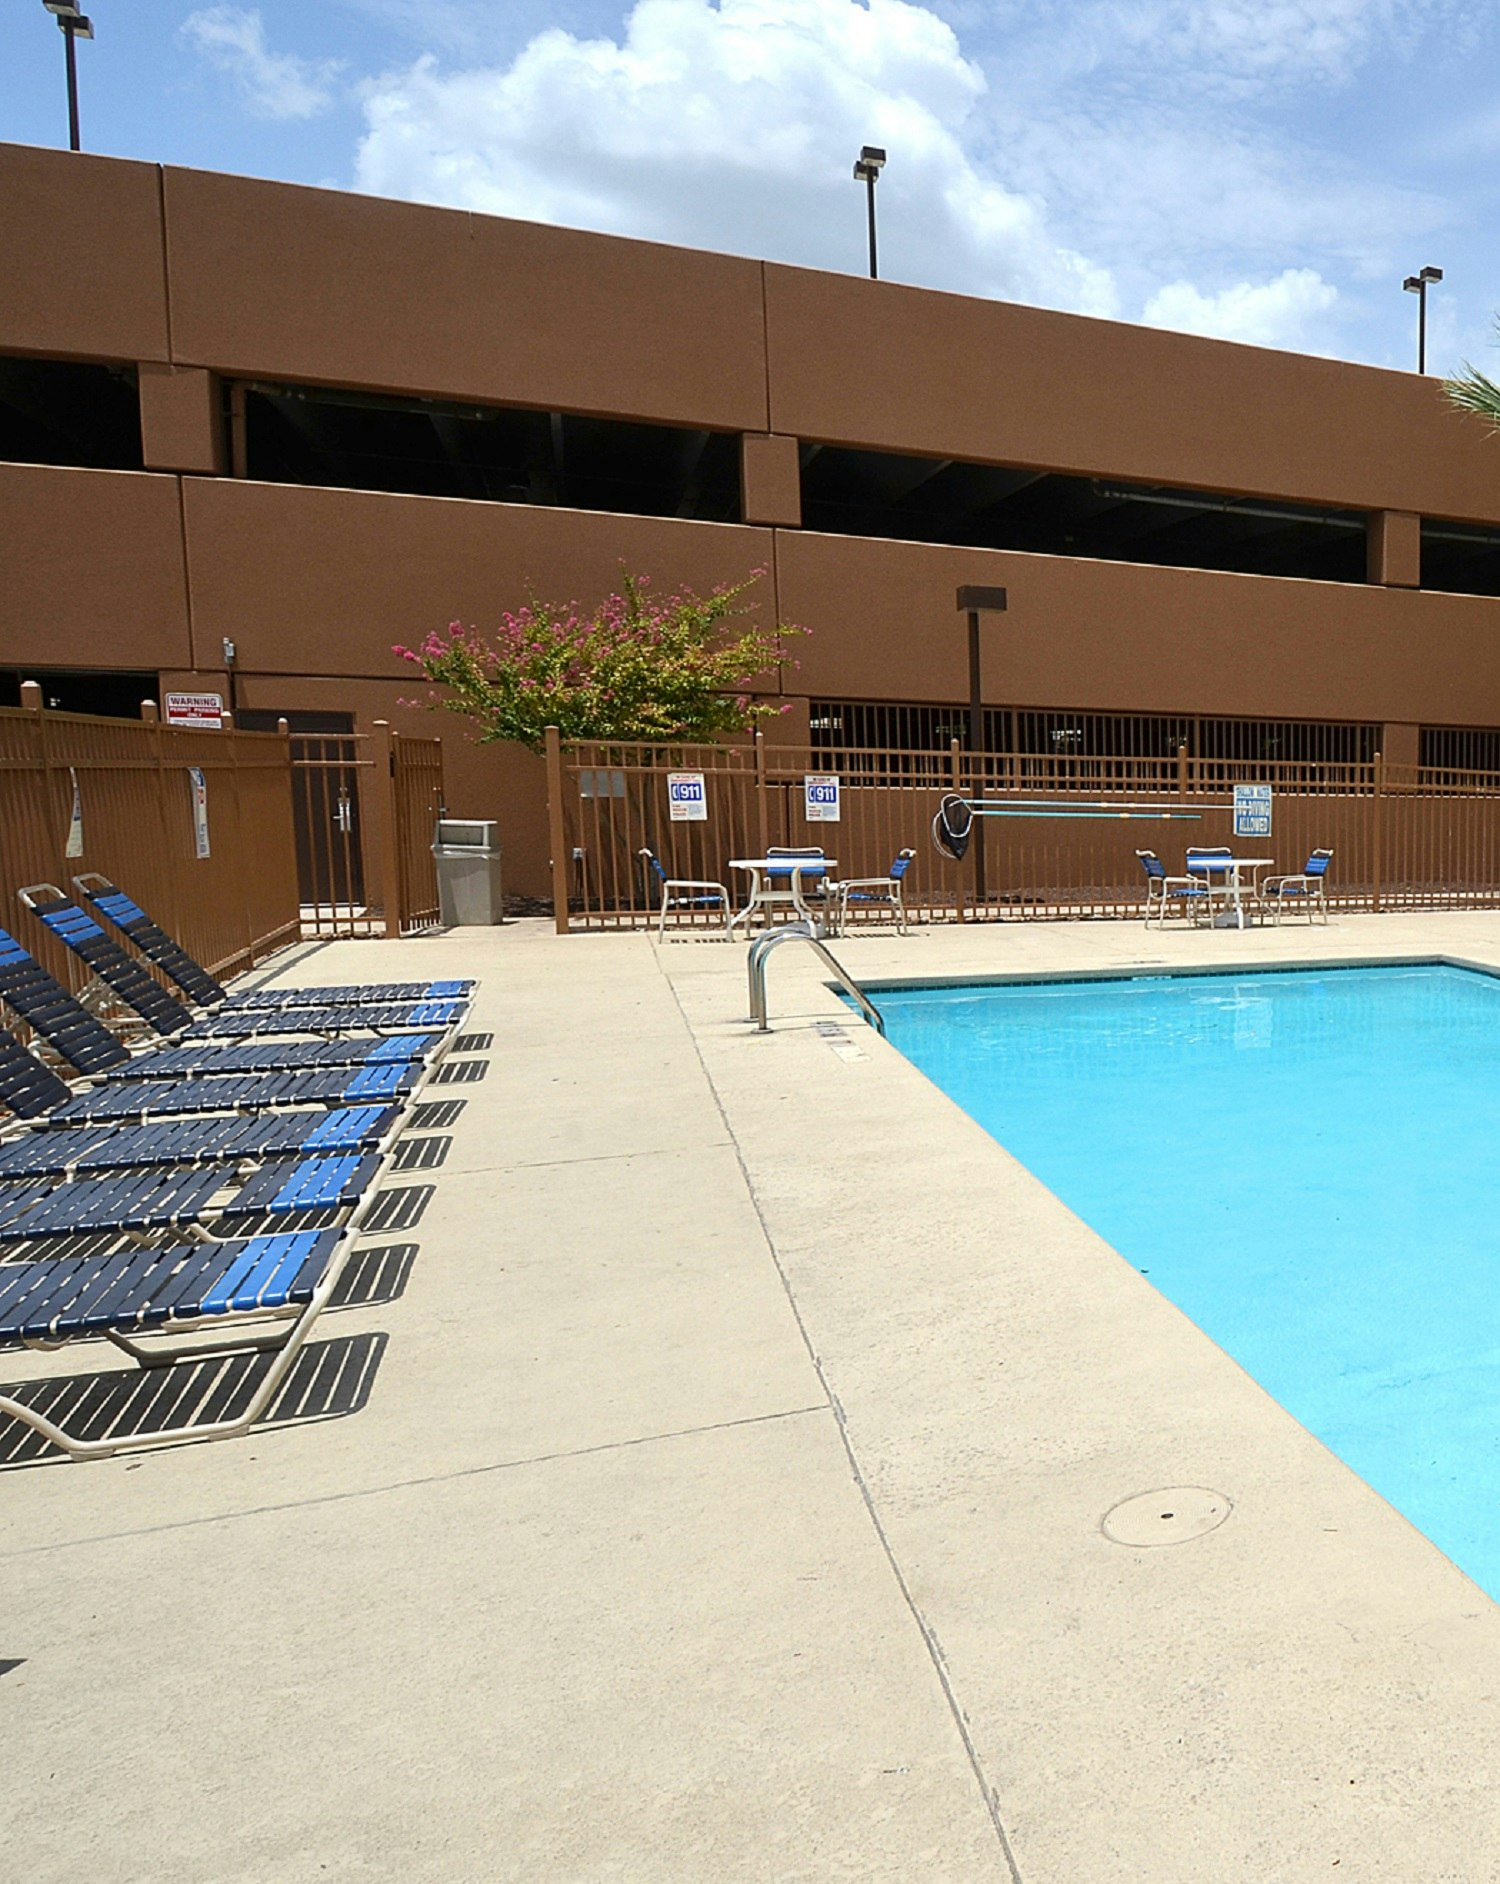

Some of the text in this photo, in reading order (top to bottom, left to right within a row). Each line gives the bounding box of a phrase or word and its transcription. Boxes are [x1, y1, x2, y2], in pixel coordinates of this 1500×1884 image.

[170, 697, 217, 706] WARNING
[680, 785, 700, 799] 911
[816, 787, 834, 801] 911
